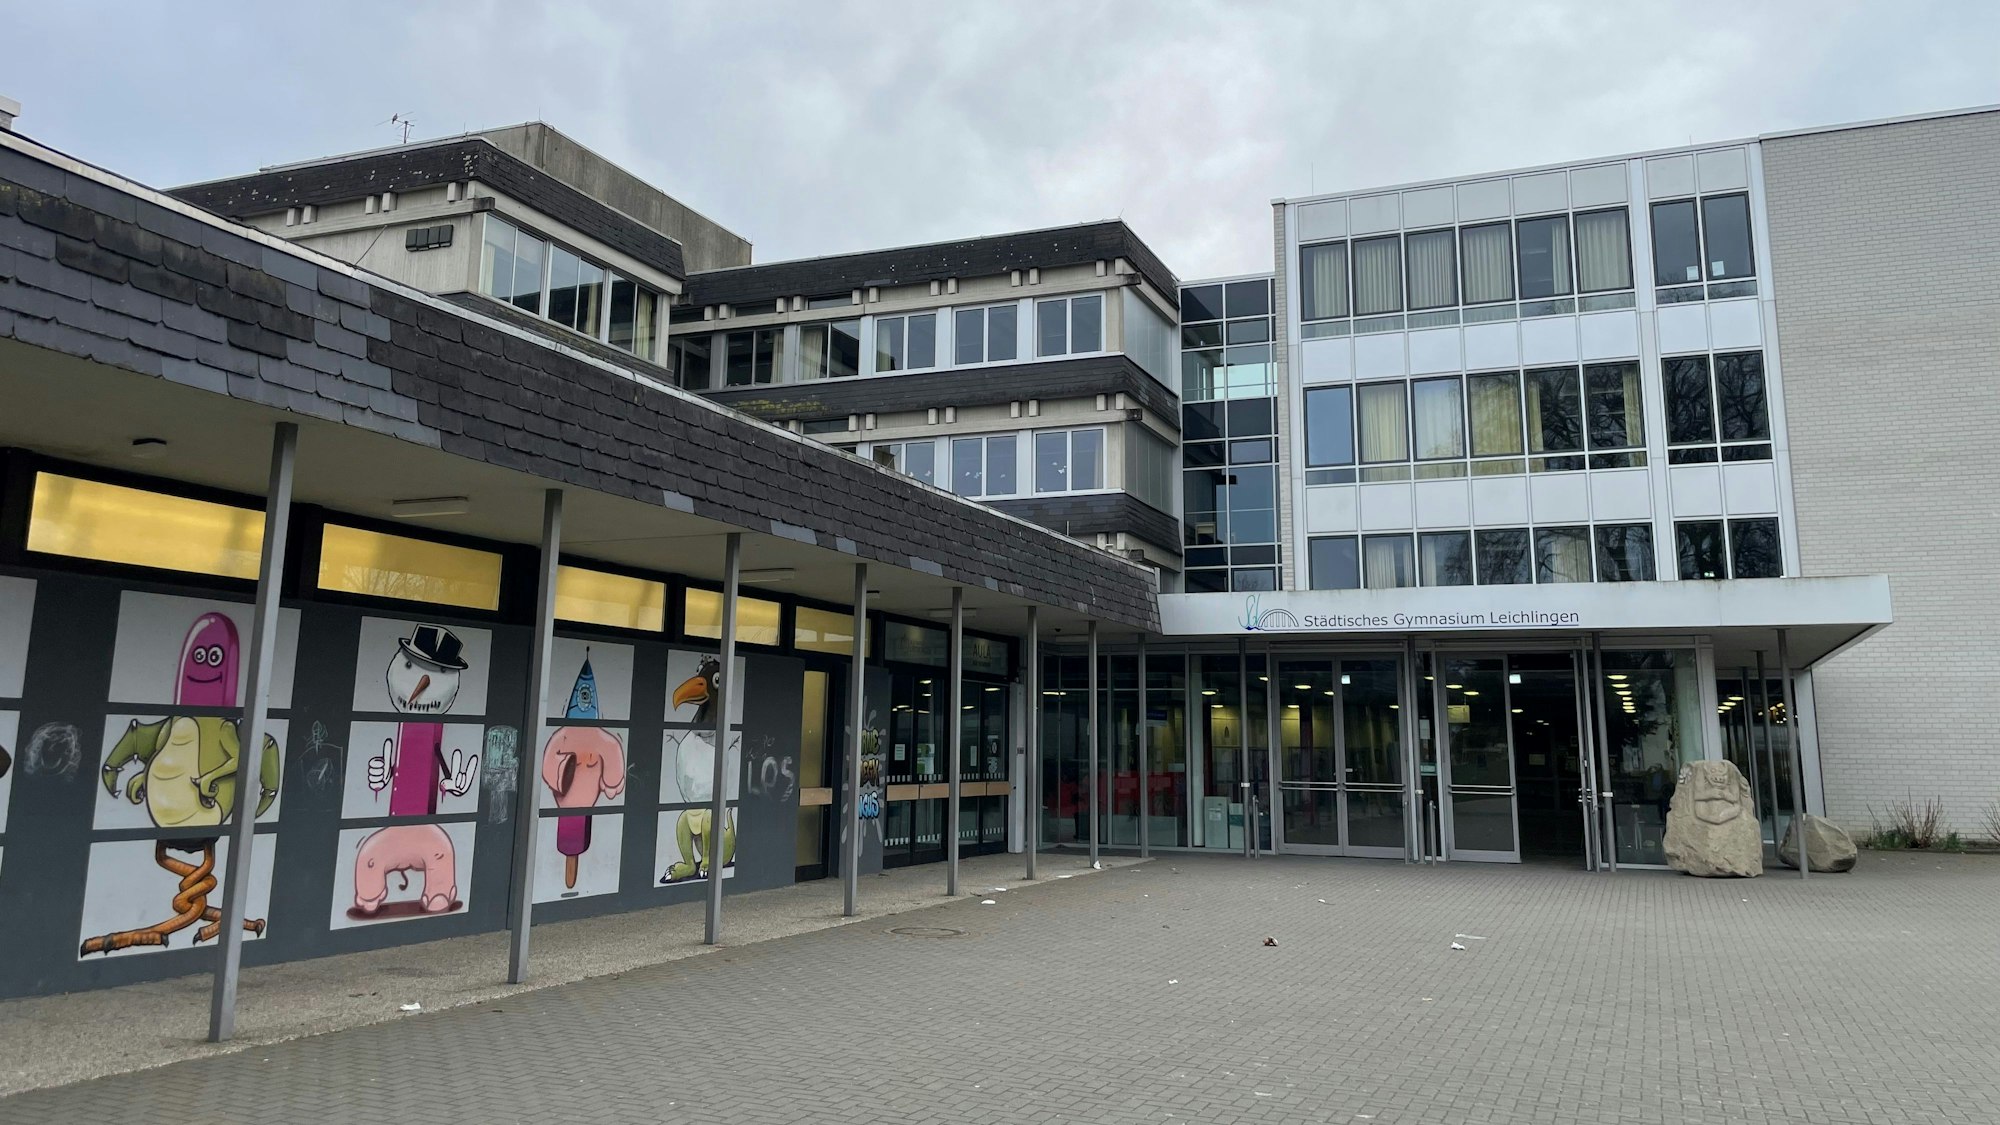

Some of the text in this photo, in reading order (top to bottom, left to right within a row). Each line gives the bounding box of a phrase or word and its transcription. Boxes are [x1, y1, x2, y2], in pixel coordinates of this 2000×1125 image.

[1304, 610, 1579, 628] Städtisches Gymnasium Leichlingen
[972, 643, 992, 659] AULA
